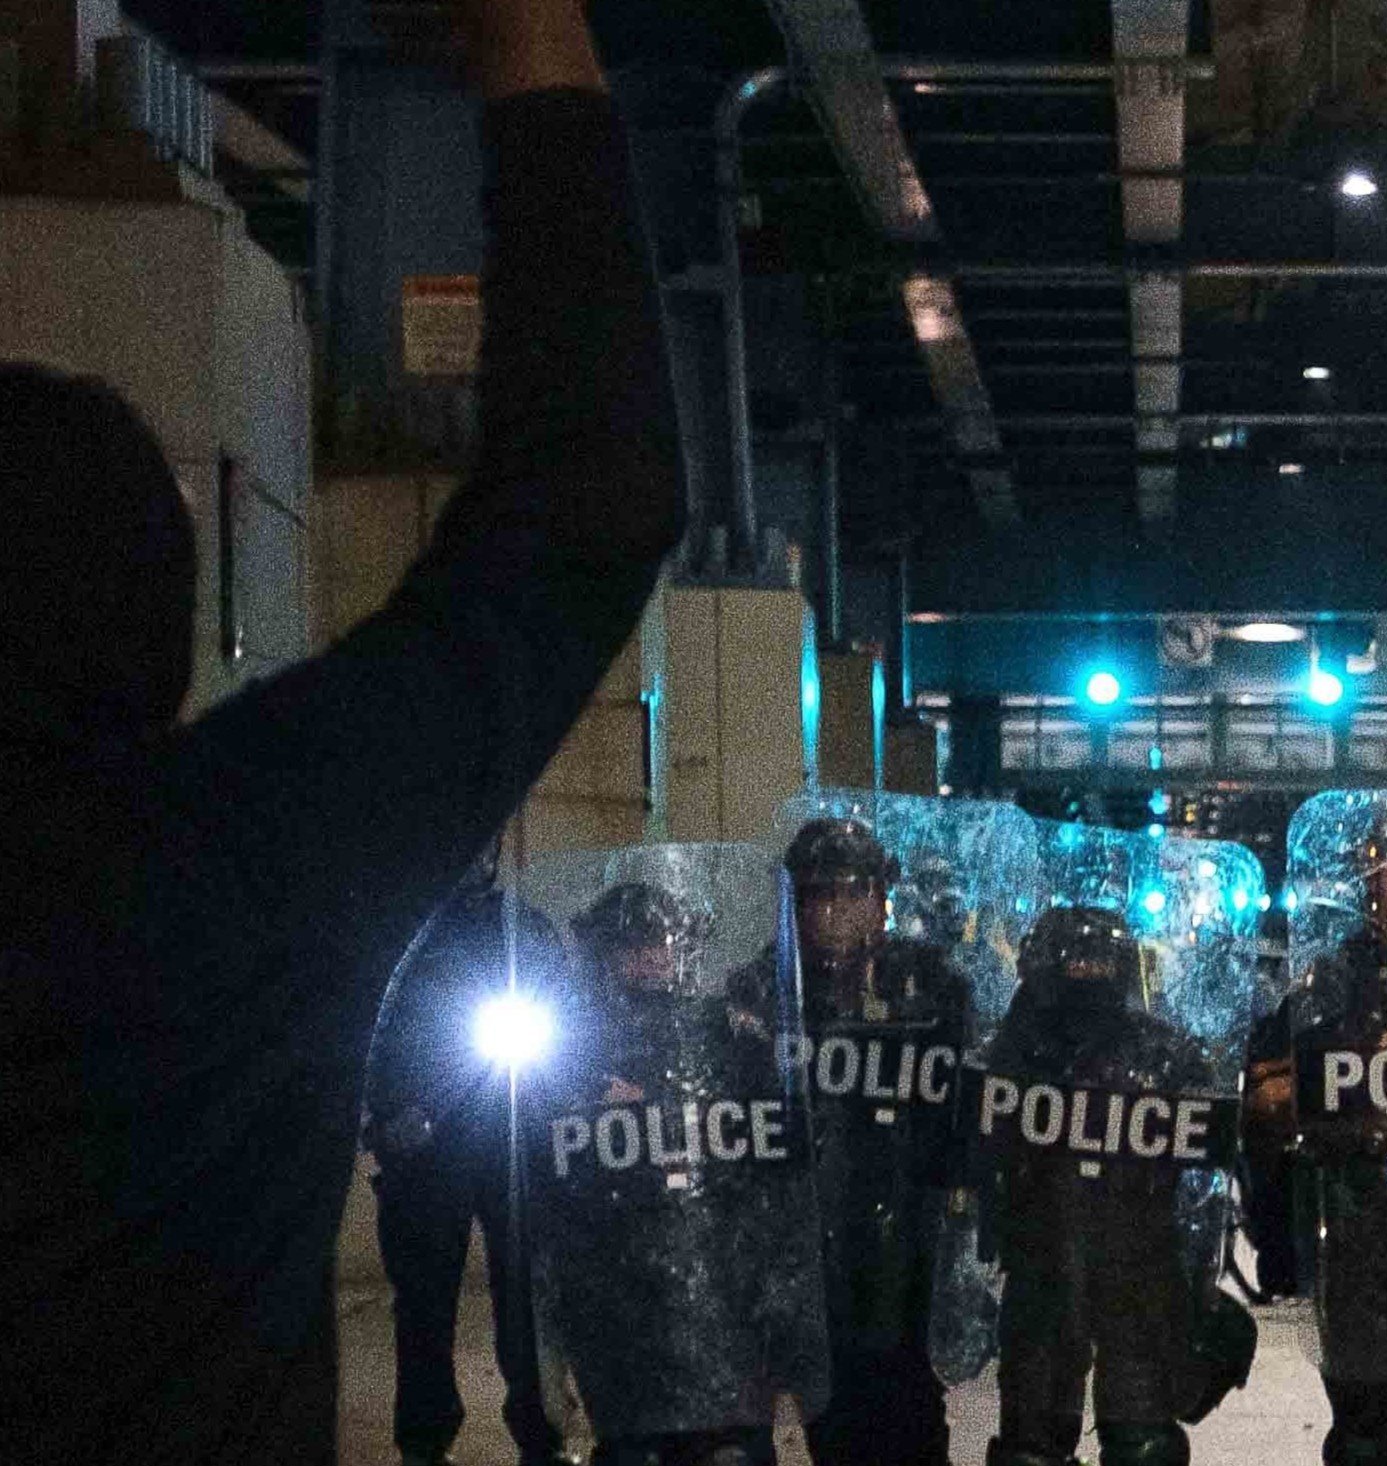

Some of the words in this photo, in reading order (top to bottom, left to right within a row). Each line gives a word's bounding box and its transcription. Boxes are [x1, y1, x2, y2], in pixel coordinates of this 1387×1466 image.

[774, 1033, 956, 1103] POLIC
[552, 1101, 788, 1178] POLICE
[980, 1075, 1211, 1159] POLICE
